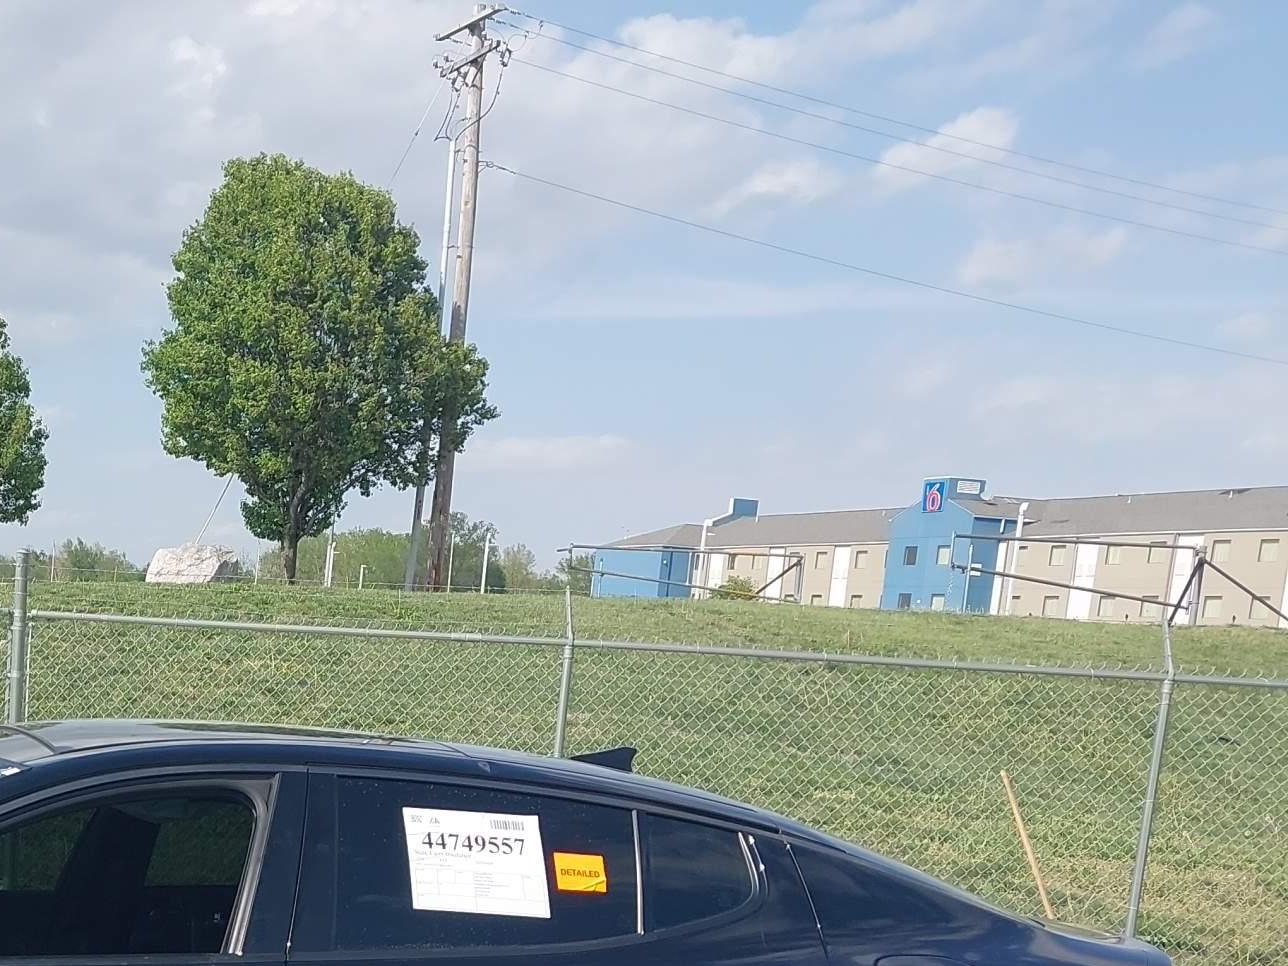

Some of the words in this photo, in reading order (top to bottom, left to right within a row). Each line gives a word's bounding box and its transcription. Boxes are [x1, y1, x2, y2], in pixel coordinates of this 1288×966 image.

[926, 483, 941, 512] 6
[421, 831, 525, 856] 44749557
[560, 867, 600, 879] DETAILED
